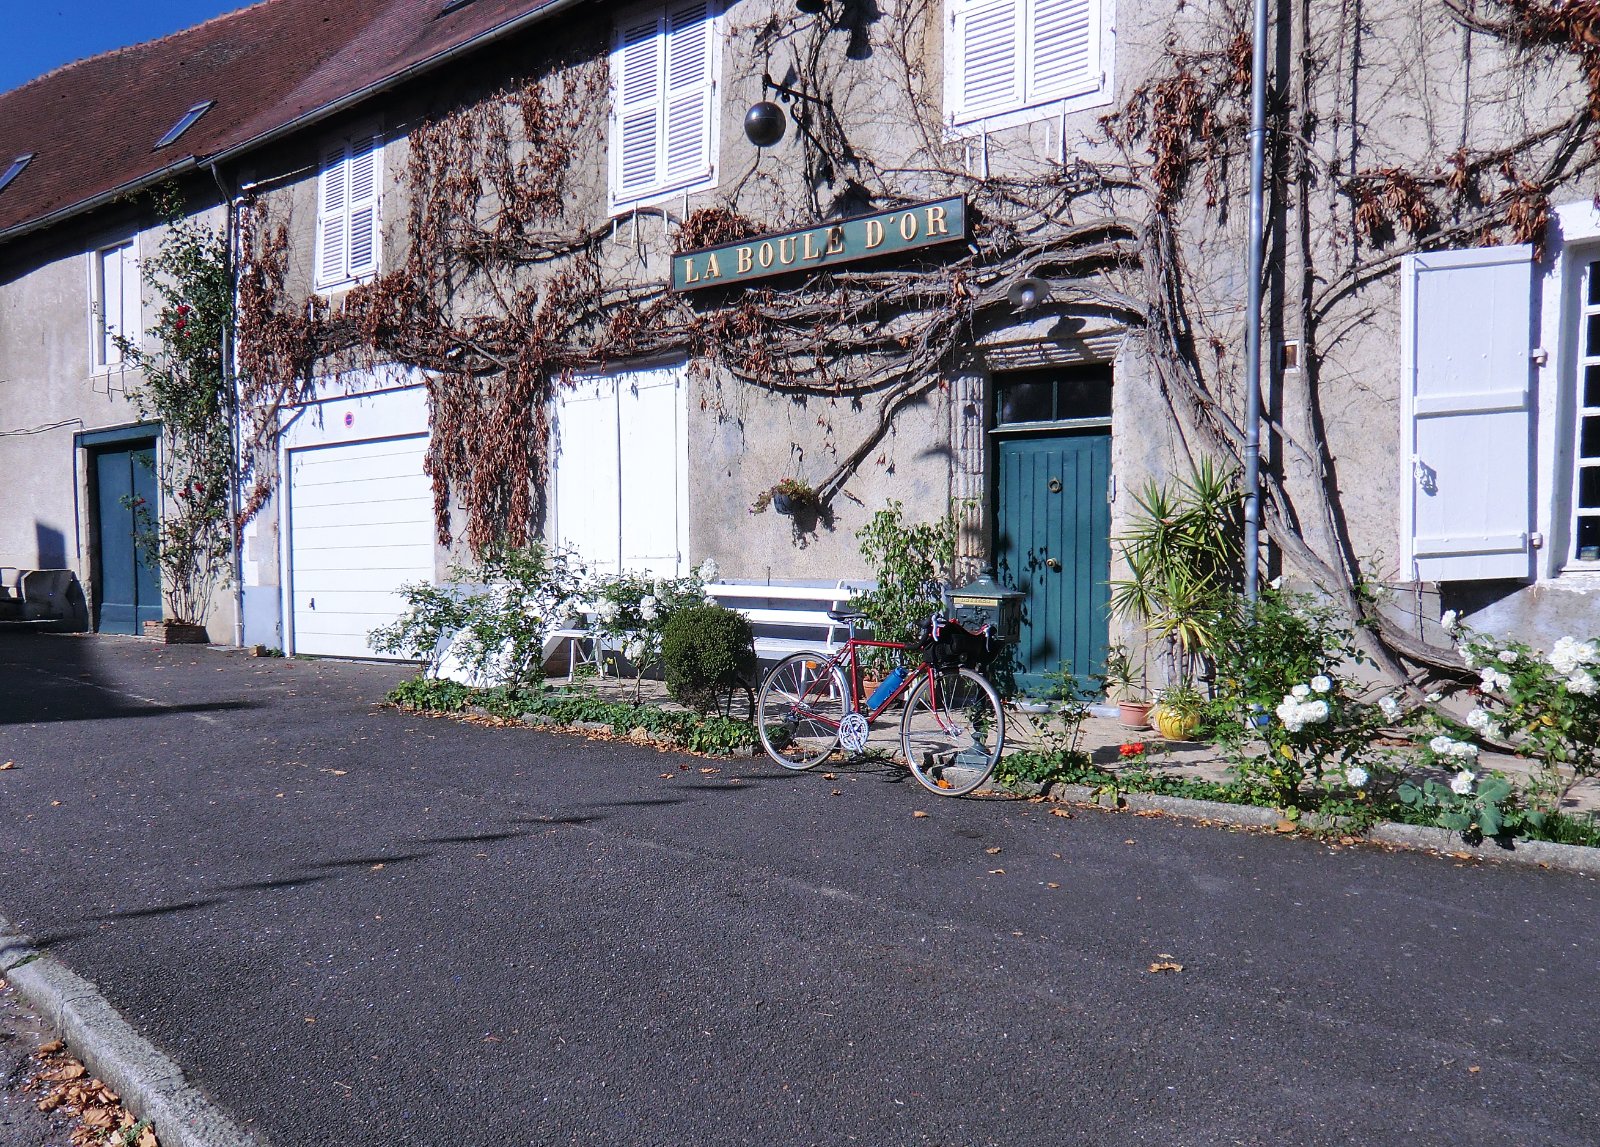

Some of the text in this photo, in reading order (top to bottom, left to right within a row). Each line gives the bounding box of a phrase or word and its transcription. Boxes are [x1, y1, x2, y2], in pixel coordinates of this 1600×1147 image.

[684, 205, 947, 283] LA BOULE D'OR
